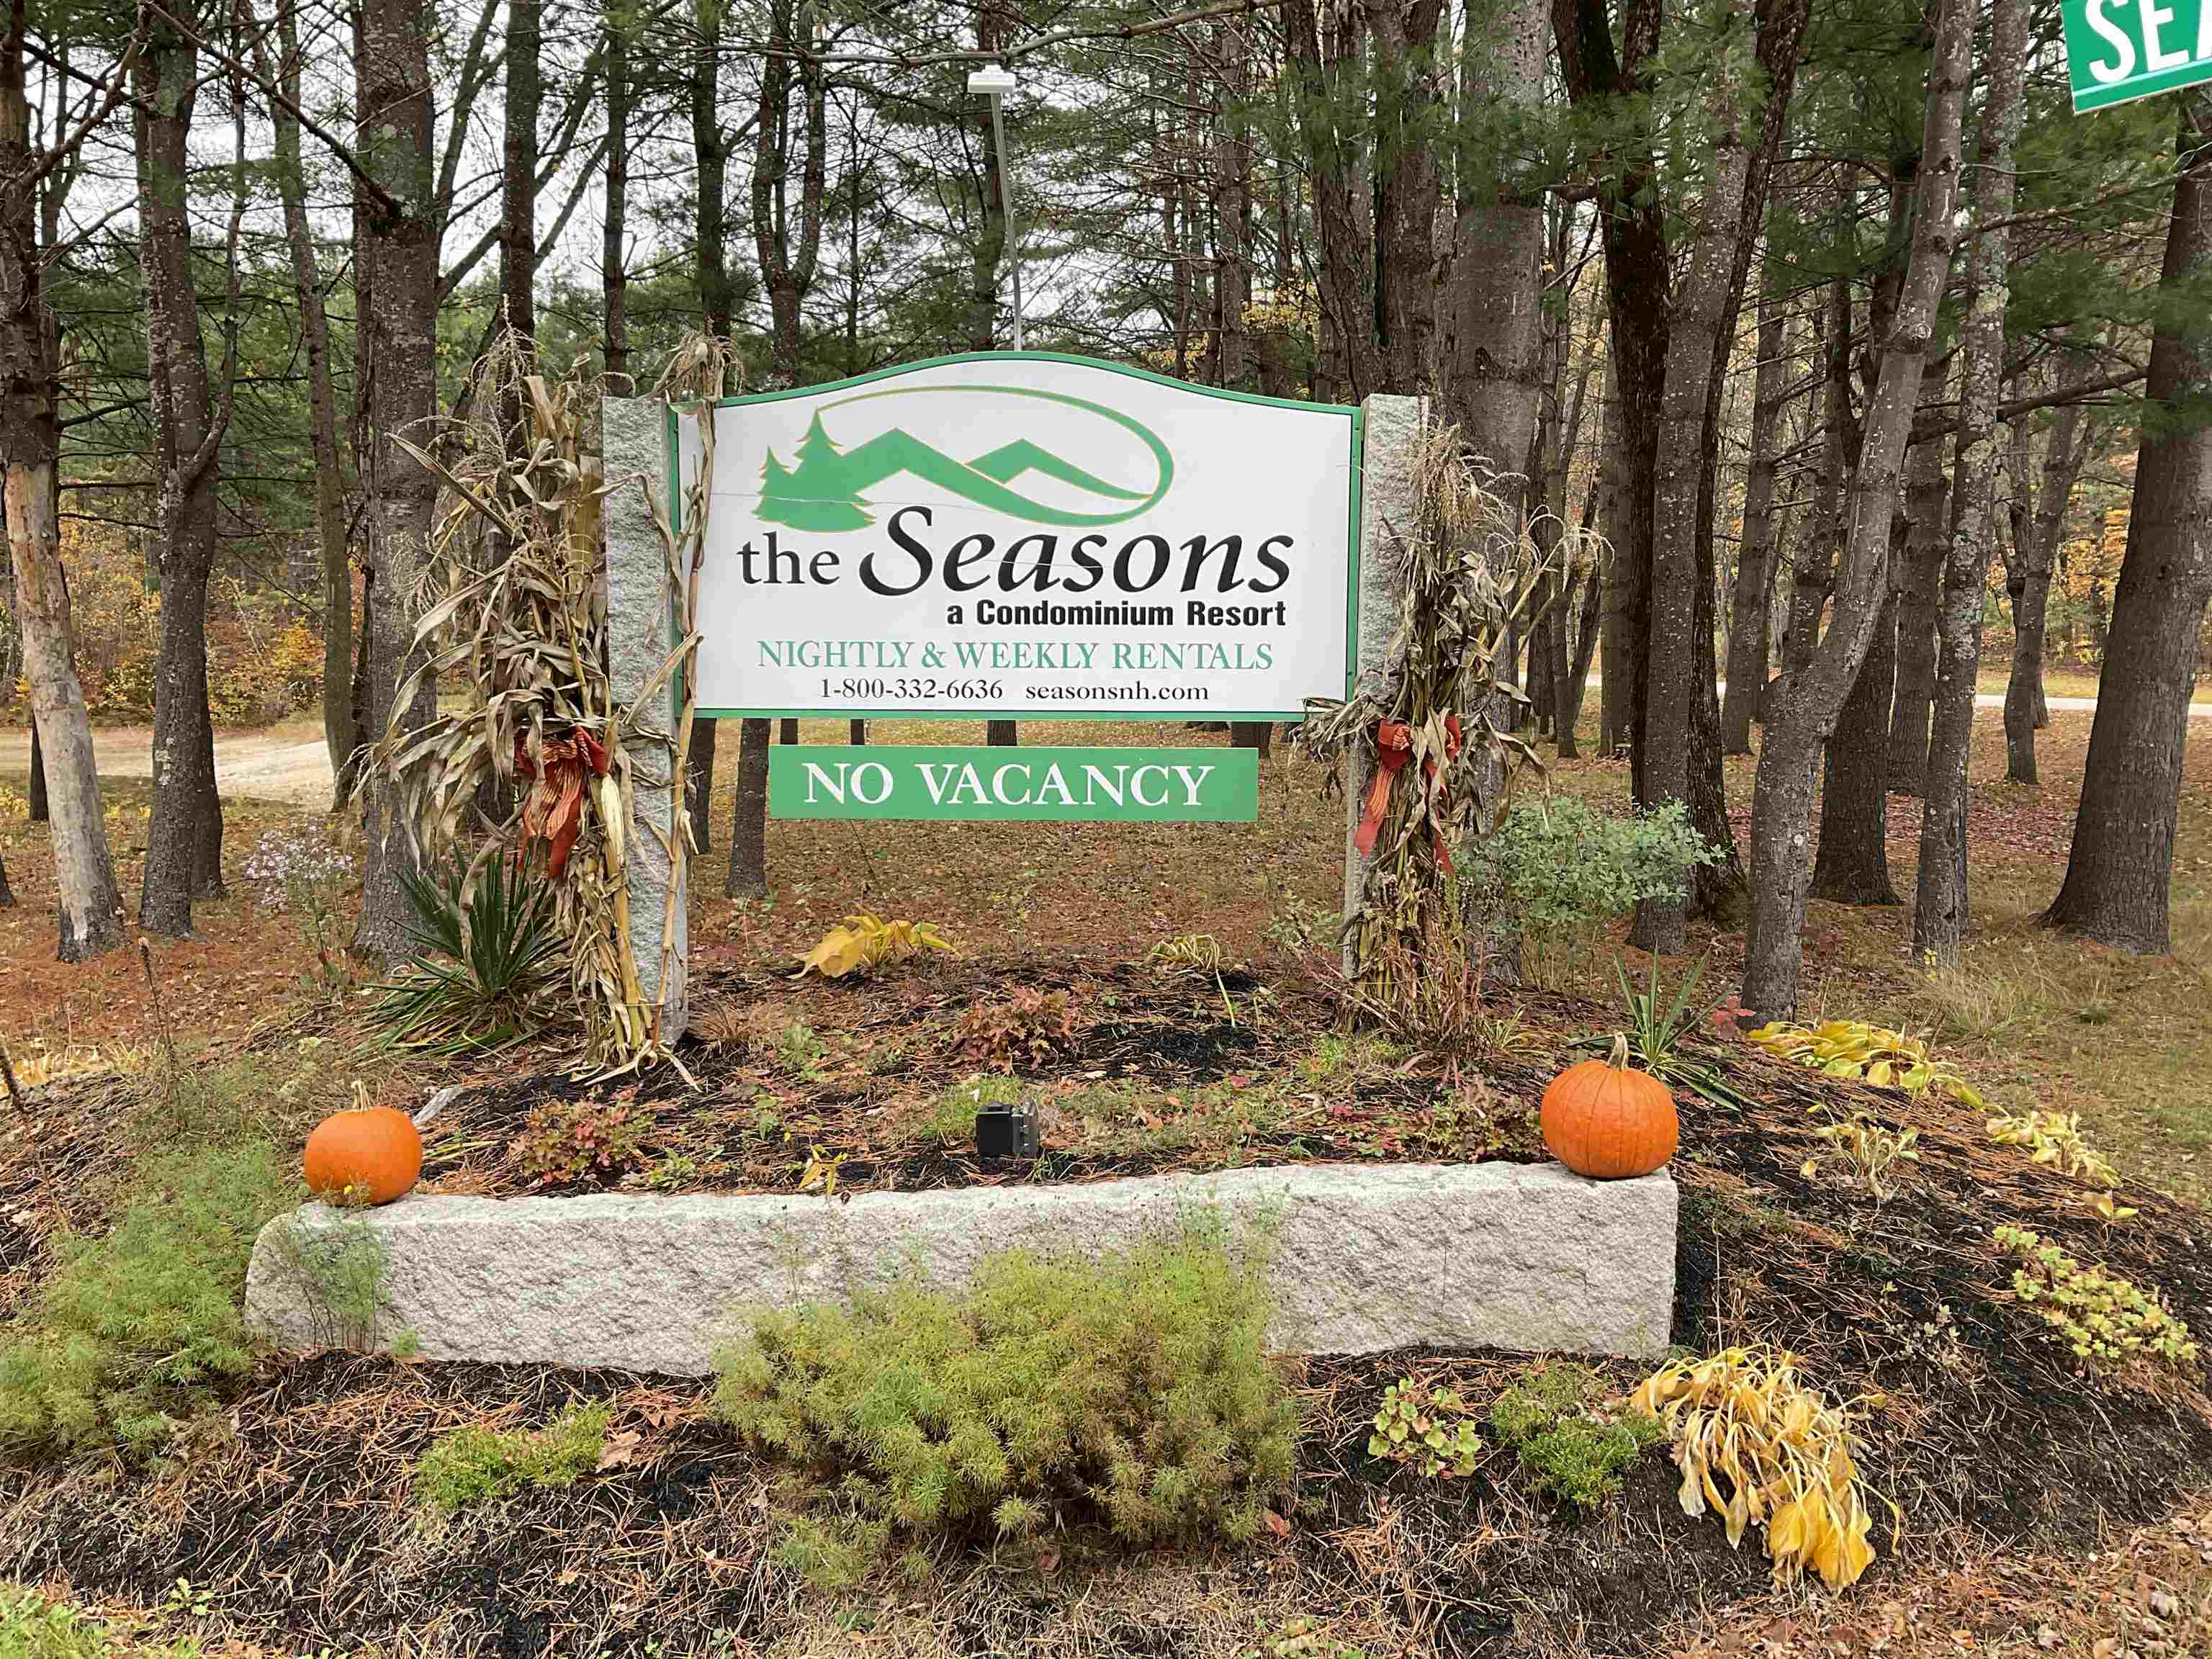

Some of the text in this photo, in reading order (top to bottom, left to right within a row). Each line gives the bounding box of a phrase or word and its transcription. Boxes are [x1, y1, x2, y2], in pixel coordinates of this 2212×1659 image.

[737, 506, 1294, 596] the Seasons
[947, 599, 1286, 626] a Condominium Resort
[758, 640, 1273, 670] NIGHTLY & WEEKLY RENTALS
[822, 678, 1208, 701] 1-800-332-6636 seasonsnh.com
[802, 762, 1215, 806] NO VACANCY
